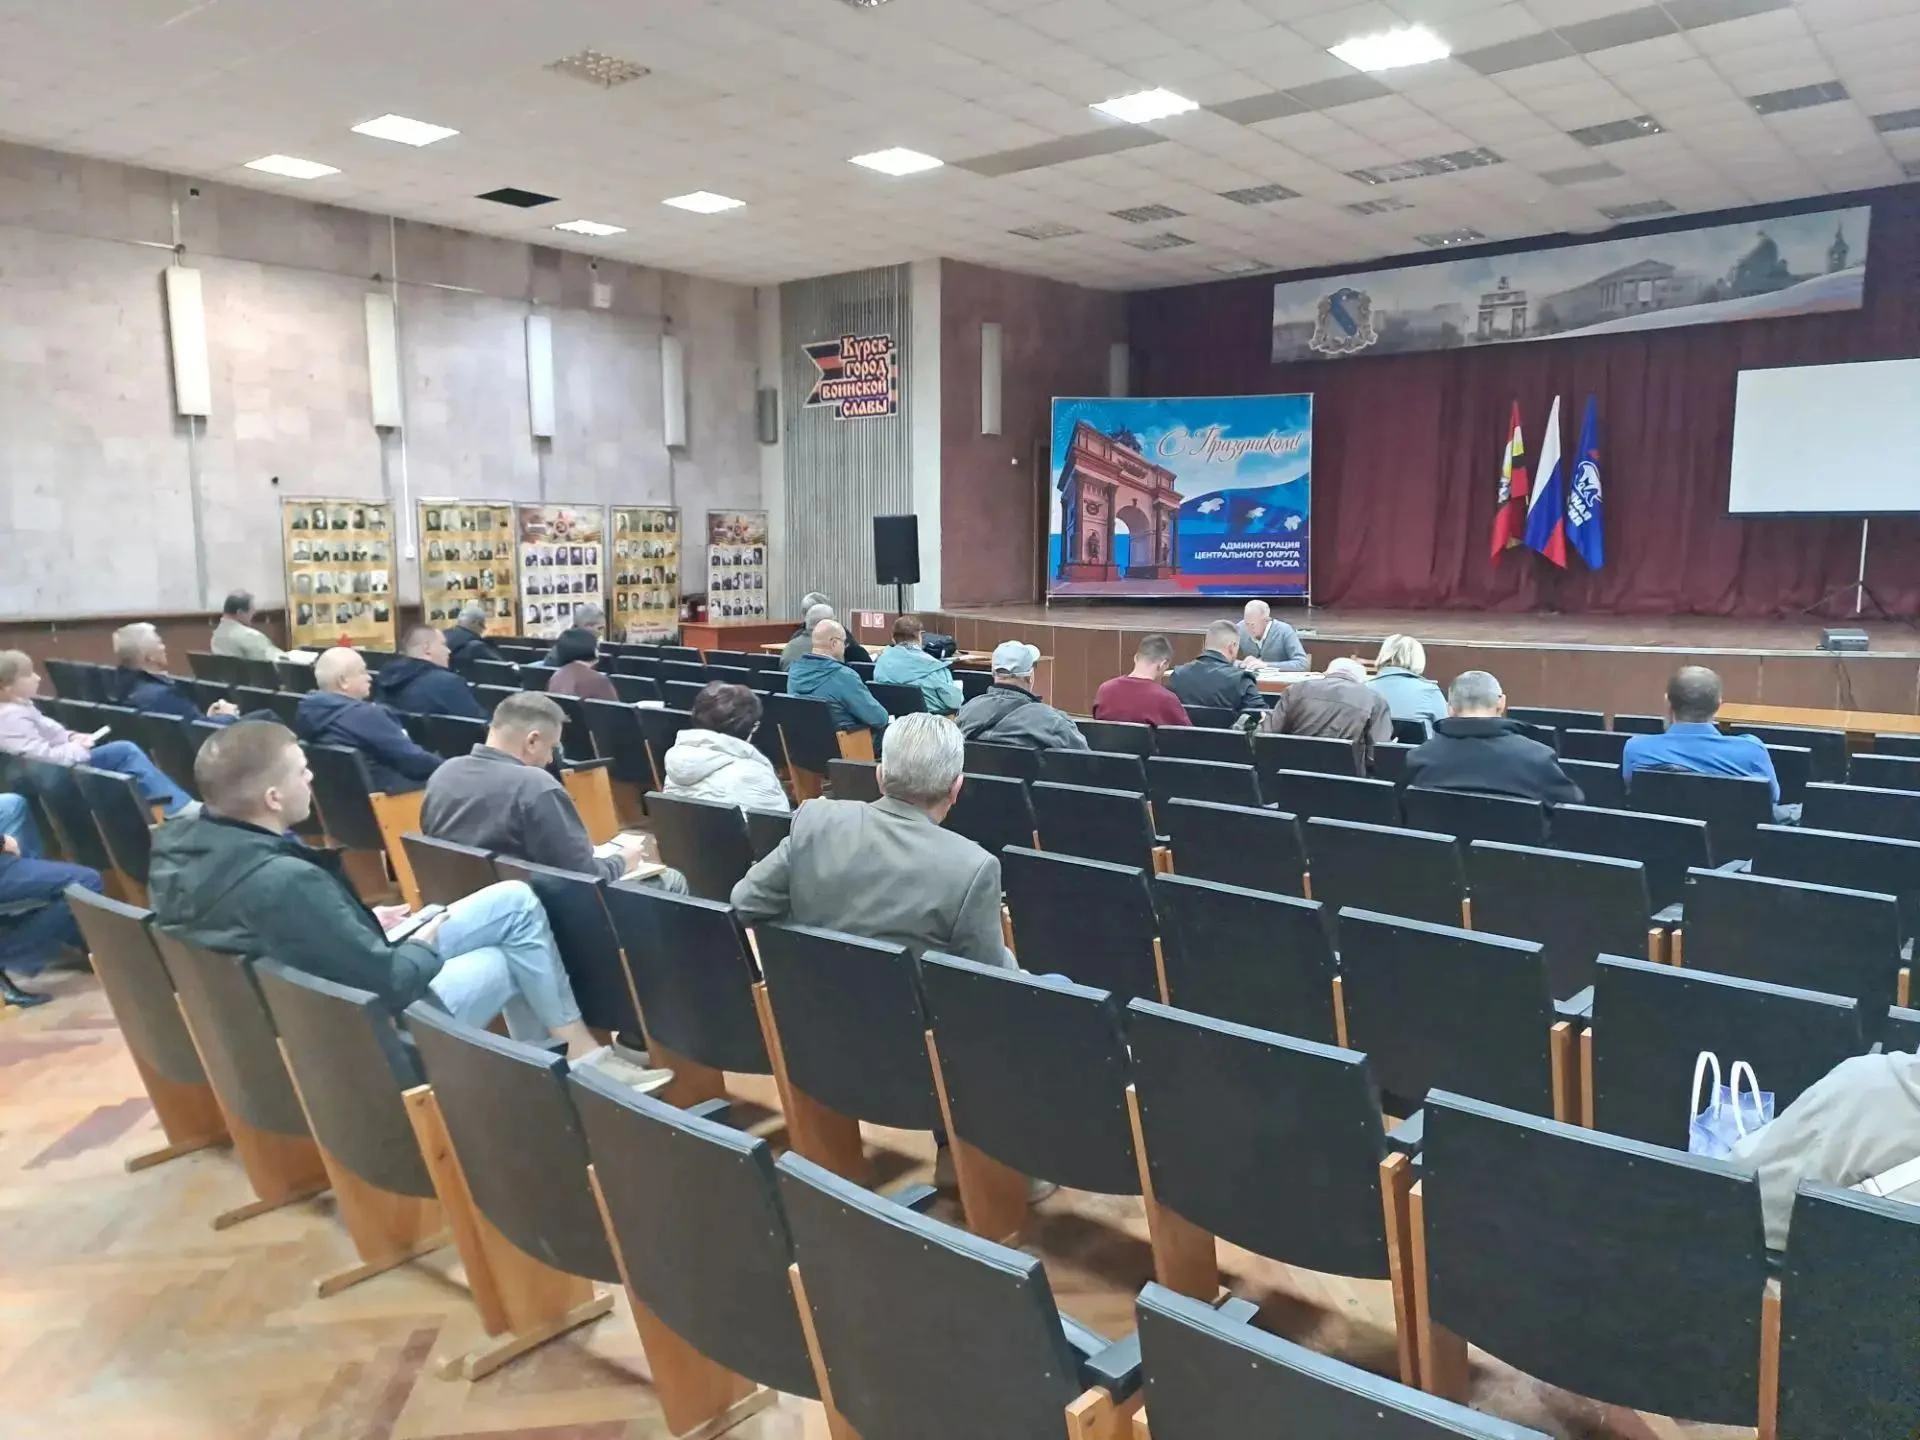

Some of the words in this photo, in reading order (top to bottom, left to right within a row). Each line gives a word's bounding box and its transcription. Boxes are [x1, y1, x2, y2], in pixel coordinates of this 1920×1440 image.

[1159, 430, 1187, 456] С
[1220, 541, 1300, 550] АДМИНИСТРАЦИЯ
[1194, 551, 1264, 559] ЦЕНТРАЛЬНОГО
[1265, 550, 1300, 558] ОКРУГА
